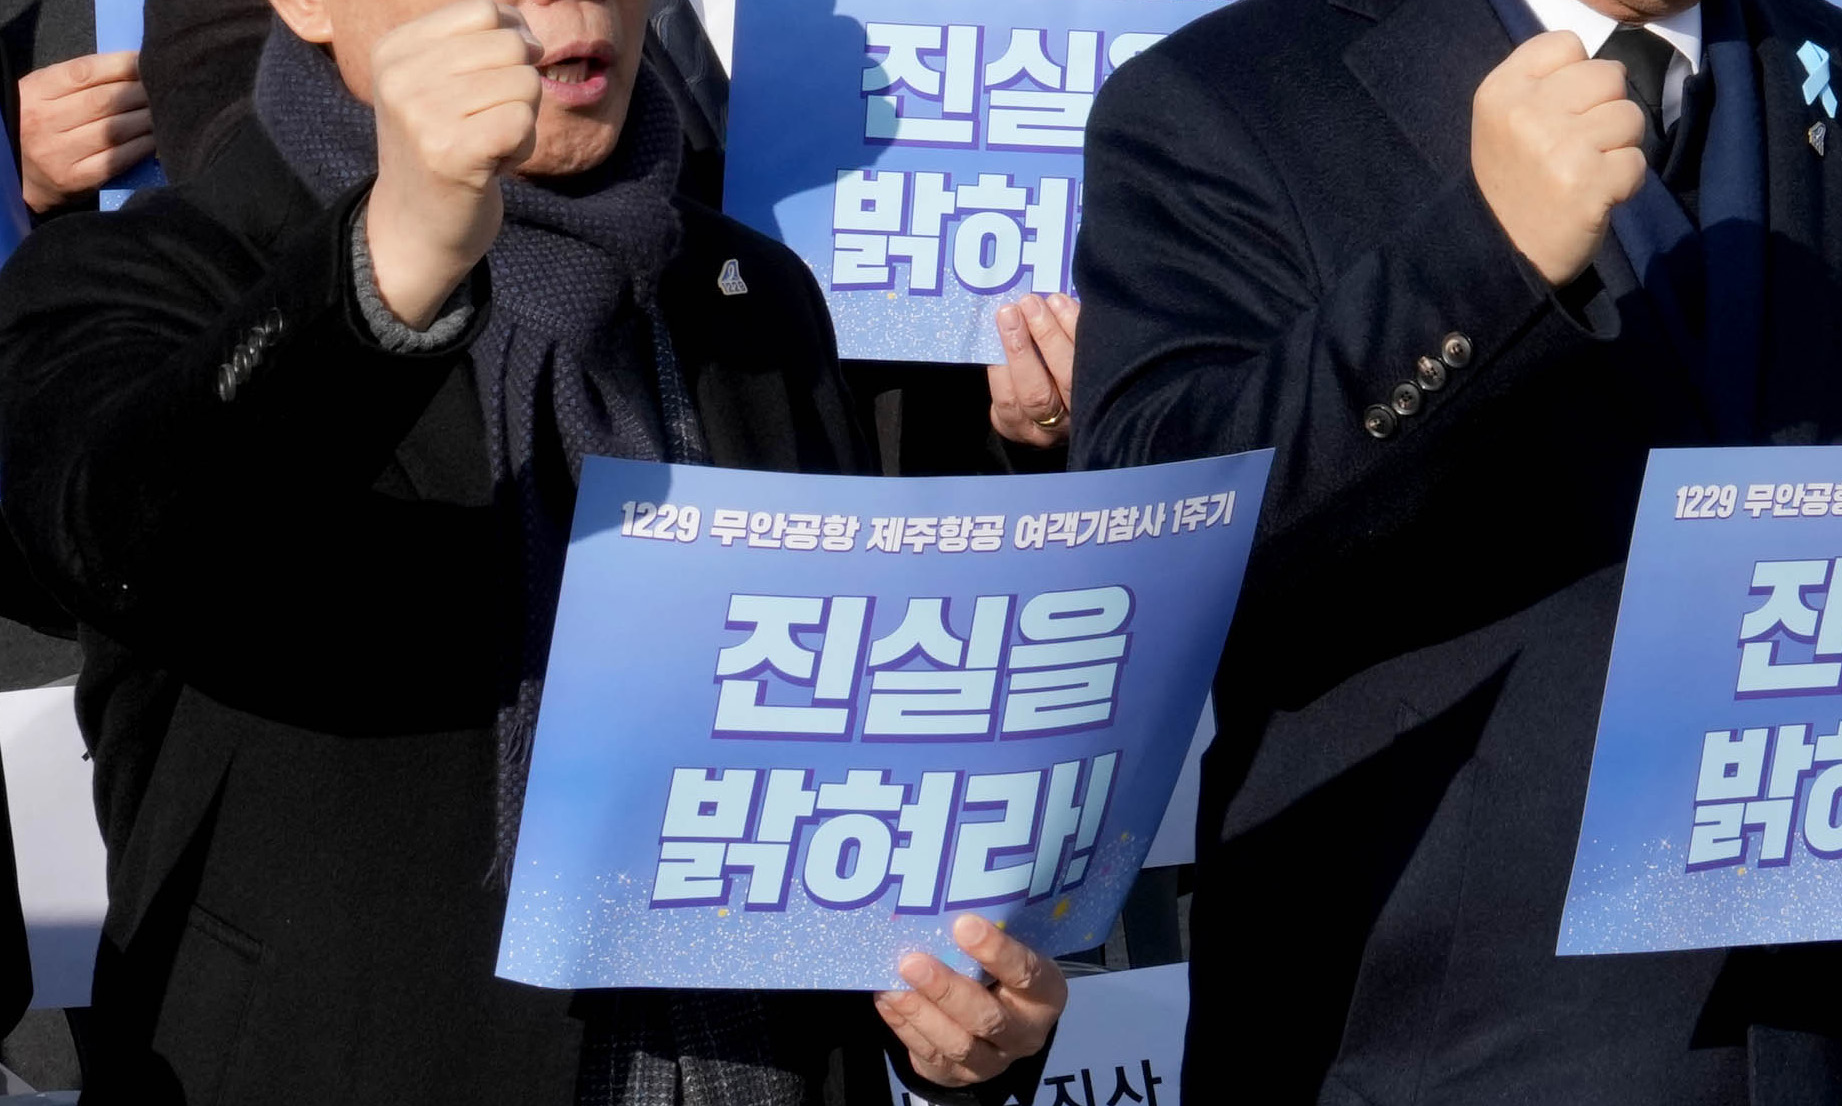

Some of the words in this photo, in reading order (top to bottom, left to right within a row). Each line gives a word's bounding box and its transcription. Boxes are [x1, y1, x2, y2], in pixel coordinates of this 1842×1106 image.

[861, 20, 1170, 154] 진실
[829, 166, 1081, 297] 밝혀
[621, 499, 701, 543] 1229
[709, 510, 862, 553] 무안공항
[865, 516, 1006, 555] 제주항공
[1012, 499, 1168, 551] 여객기참사
[1170, 489, 1238, 537] 1주기
[1675, 483, 1738, 520] 1229
[710, 583, 1136, 743] 진실을
[648, 749, 1124, 917] 밝혀라!
